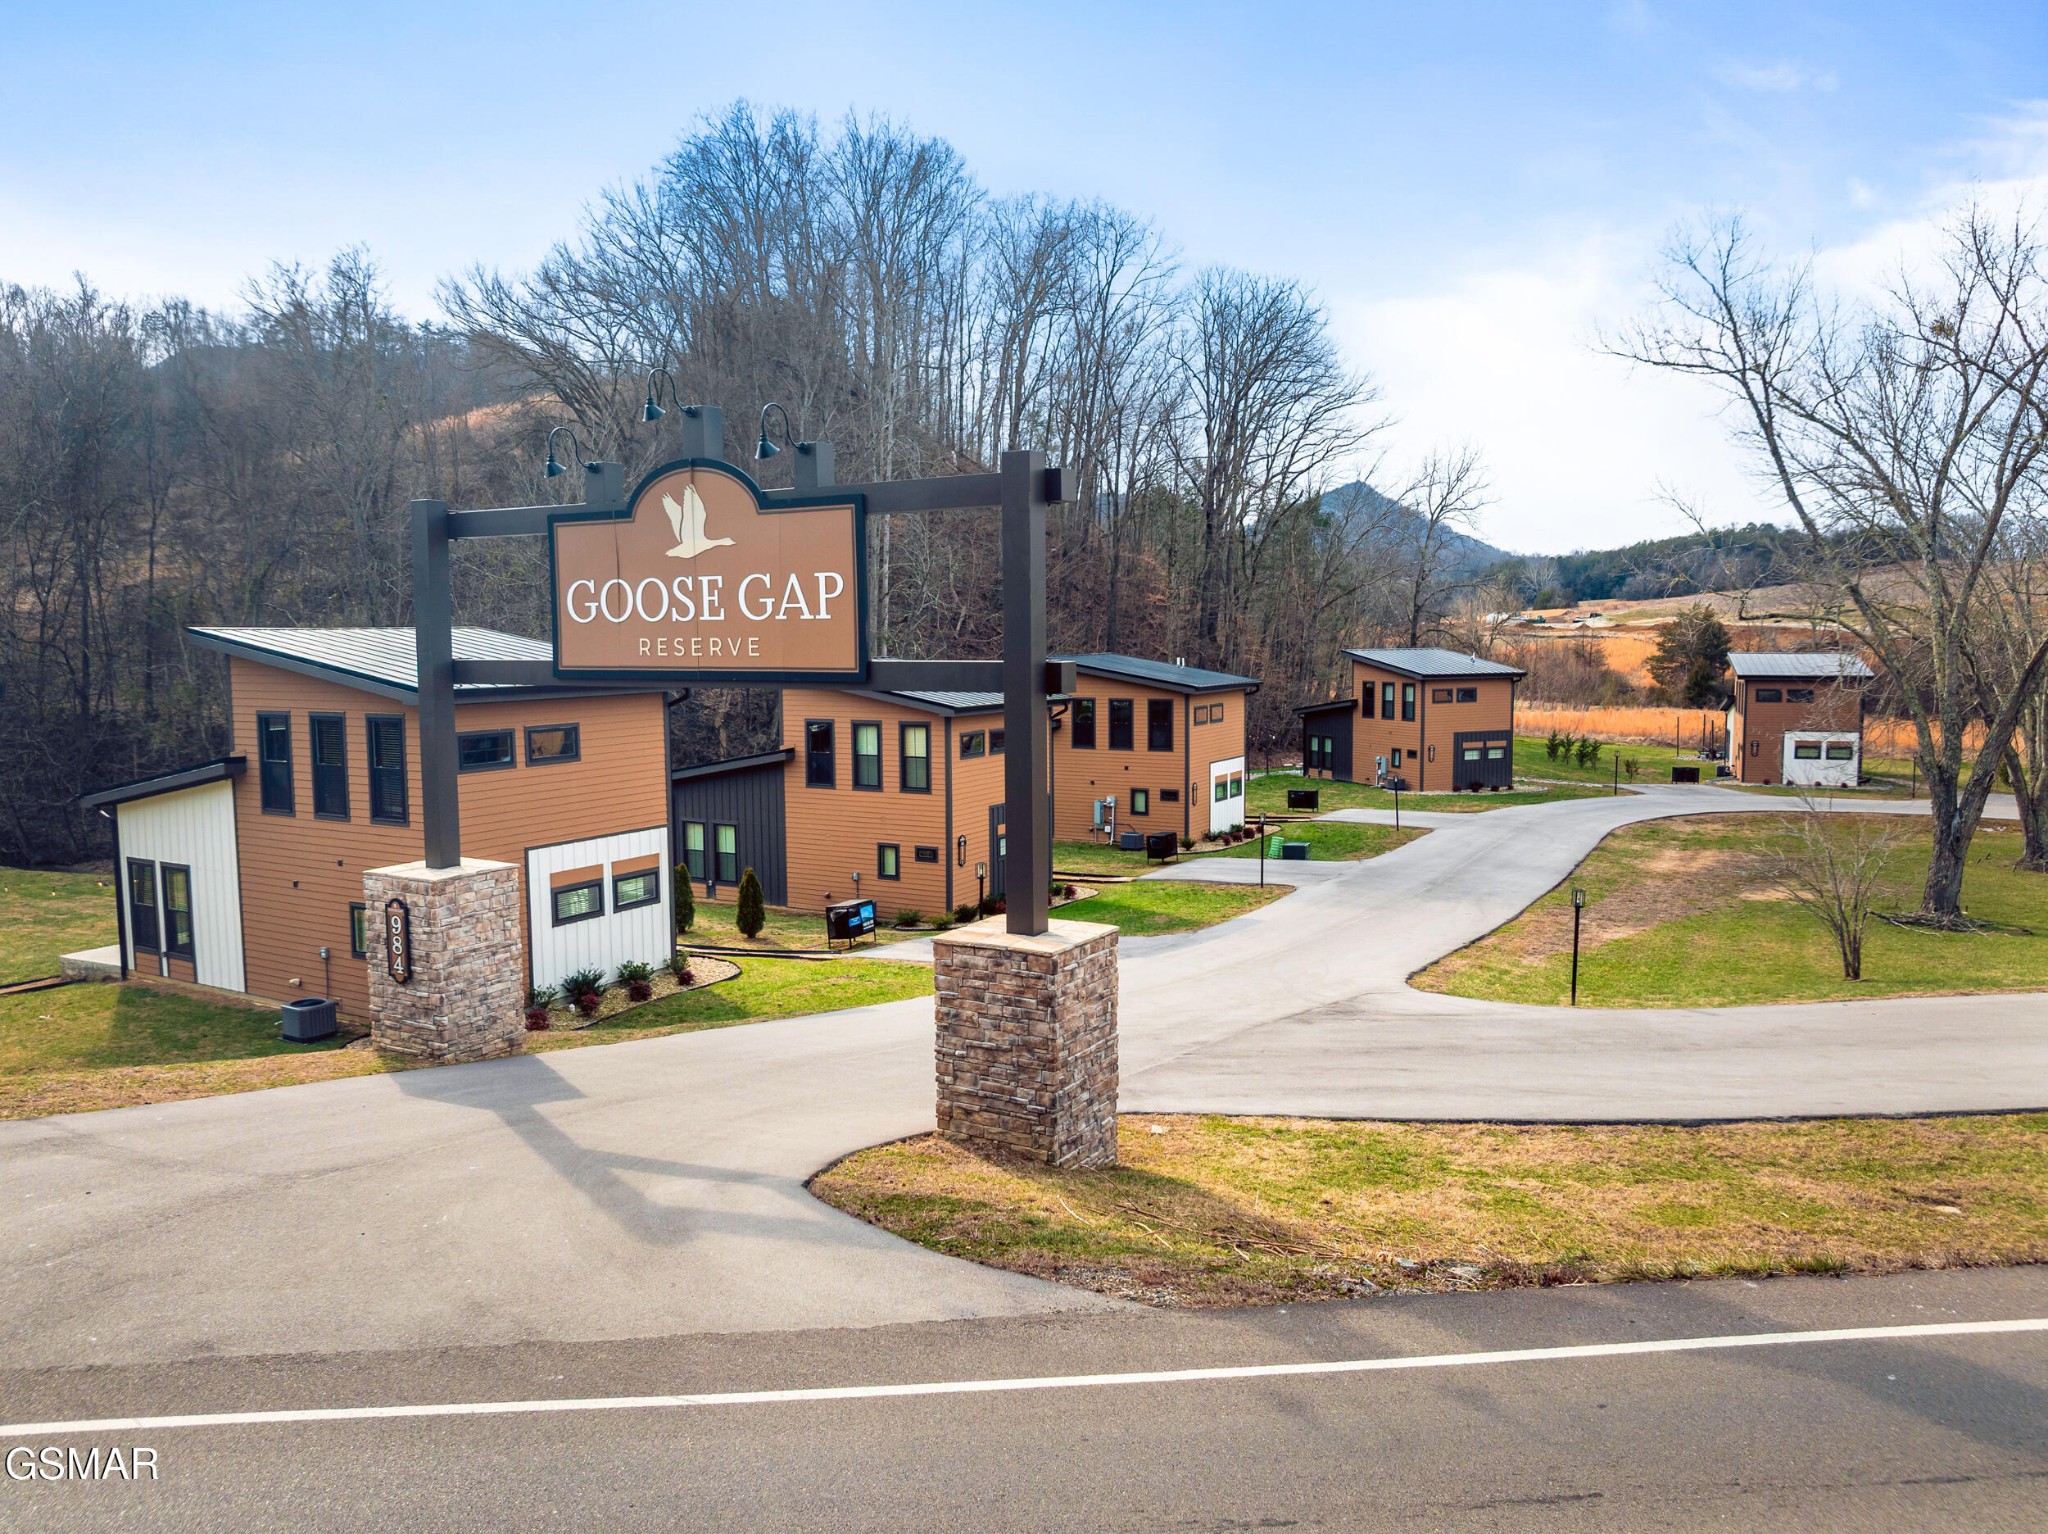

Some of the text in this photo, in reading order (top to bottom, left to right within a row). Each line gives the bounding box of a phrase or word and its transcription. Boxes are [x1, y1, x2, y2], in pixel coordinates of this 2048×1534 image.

[566, 572, 844, 623] GOOSE GAP
[639, 637, 760, 656] RESERVE
[391, 915, 404, 974] 984
